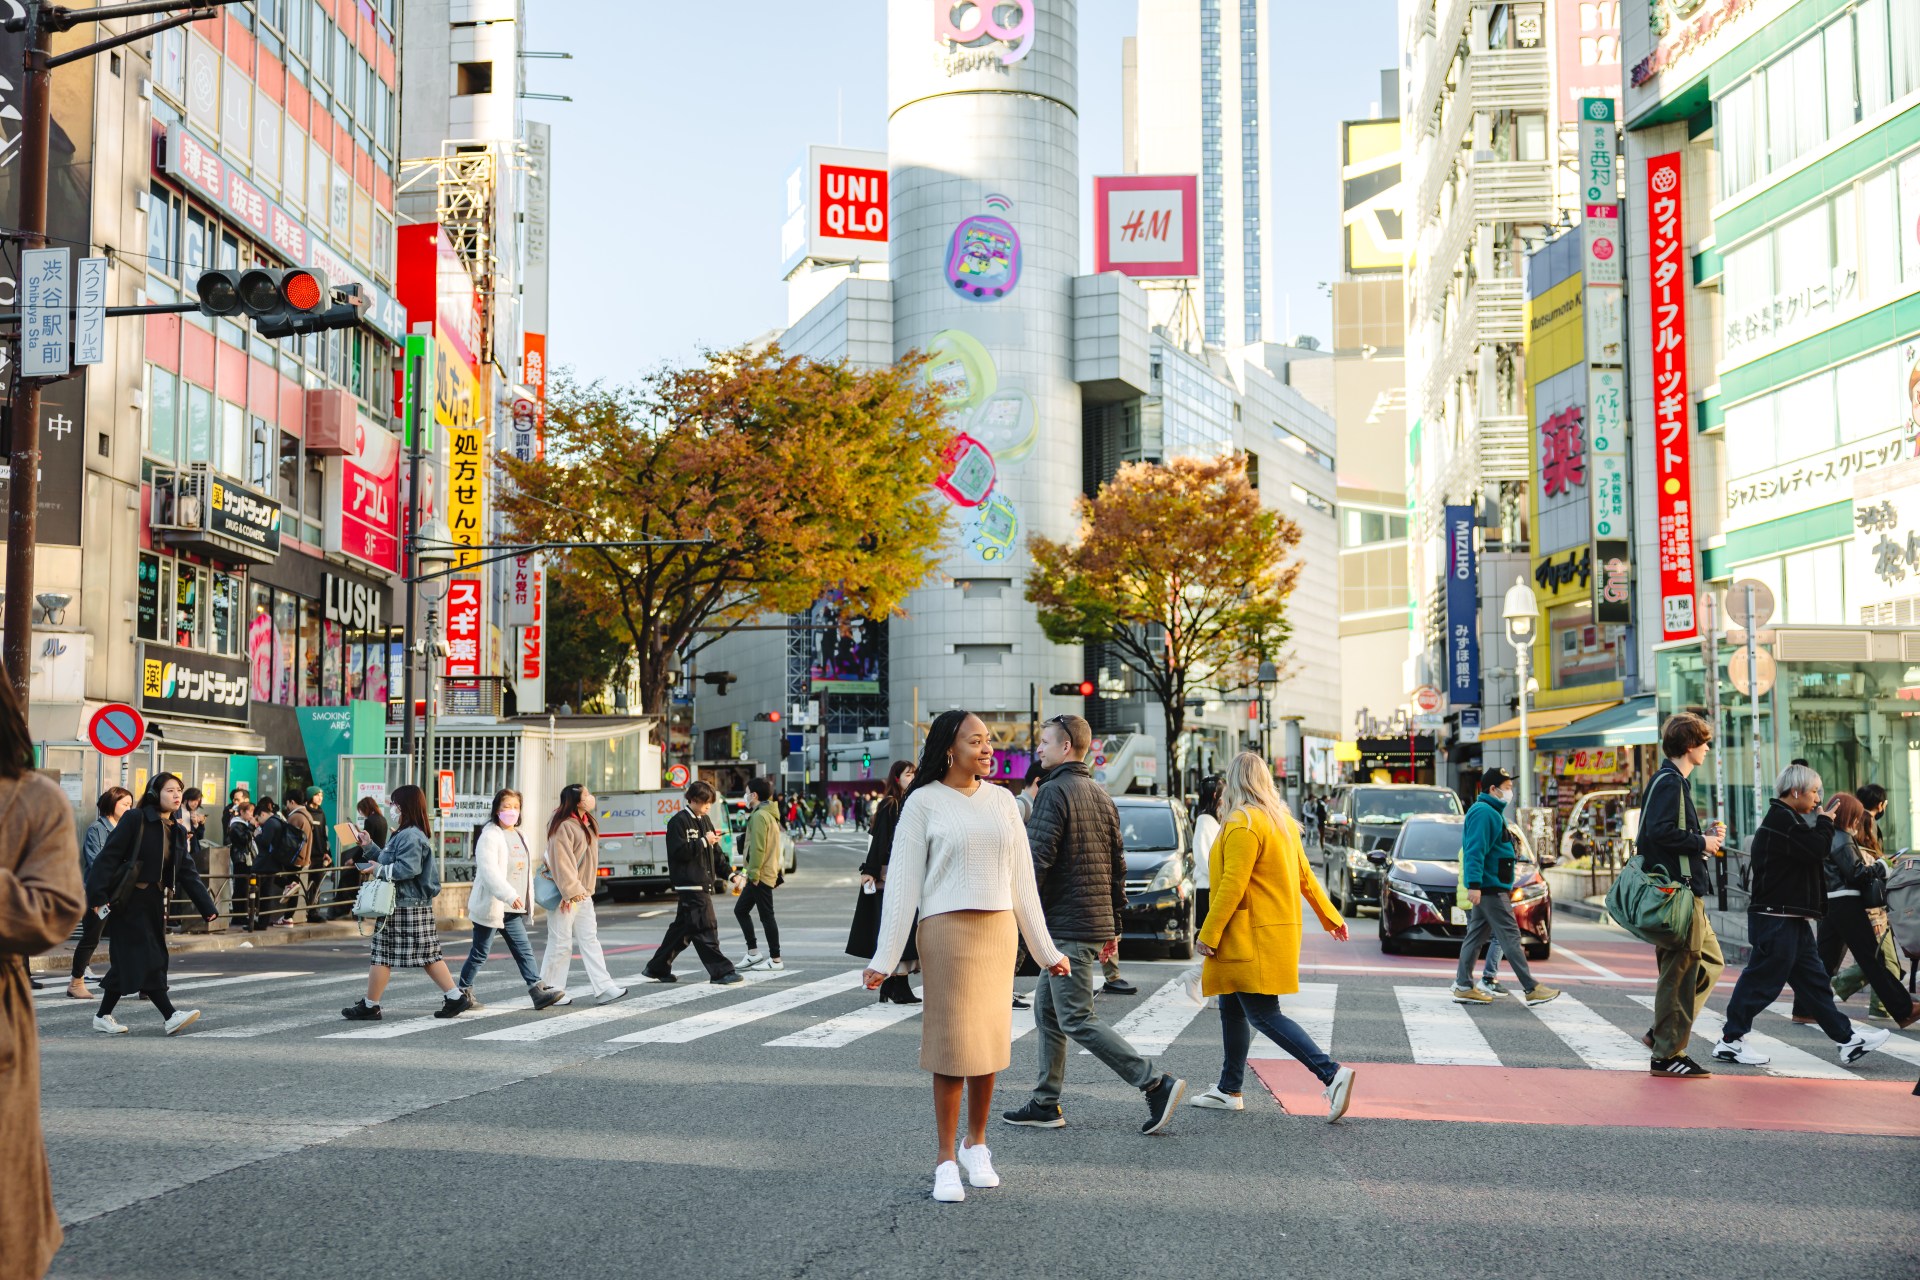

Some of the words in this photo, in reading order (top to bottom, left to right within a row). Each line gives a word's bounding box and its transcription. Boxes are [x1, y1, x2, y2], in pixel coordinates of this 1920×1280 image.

[826, 173, 878, 204] UNI
[826, 203, 884, 235] QLO
[1120, 209, 1172, 242] H&M
[27, 276, 40, 325] Shibuya
[42, 259, 63, 364] 渋谷駅前
[81, 262, 102, 361] スクランブル式
[382, 299, 405, 338] 4F
[28, 328, 40, 352] Sta.
[1653, 196, 1683, 474] ウィンターフルーツギフト
[1541, 405, 1585, 499] 薬
[353, 472, 389, 526] アコム
[454, 434, 478, 529] 処方せん
[223, 489, 272, 528] サンドラッグ
[364, 531, 377, 557] 3F
[1456, 520, 1470, 580] MIZUHO
[325, 572, 382, 634] LUSH
[1455, 624, 1471, 689] みずほ銀行
[146, 663, 159, 693] 薬
[177, 666, 248, 706] サンドラッグ
[312, 712, 351, 721] SMOKING
[330, 721, 351, 730] AREA
[610, 808, 646, 817] ALSOK
[657, 799, 681, 815] 234
